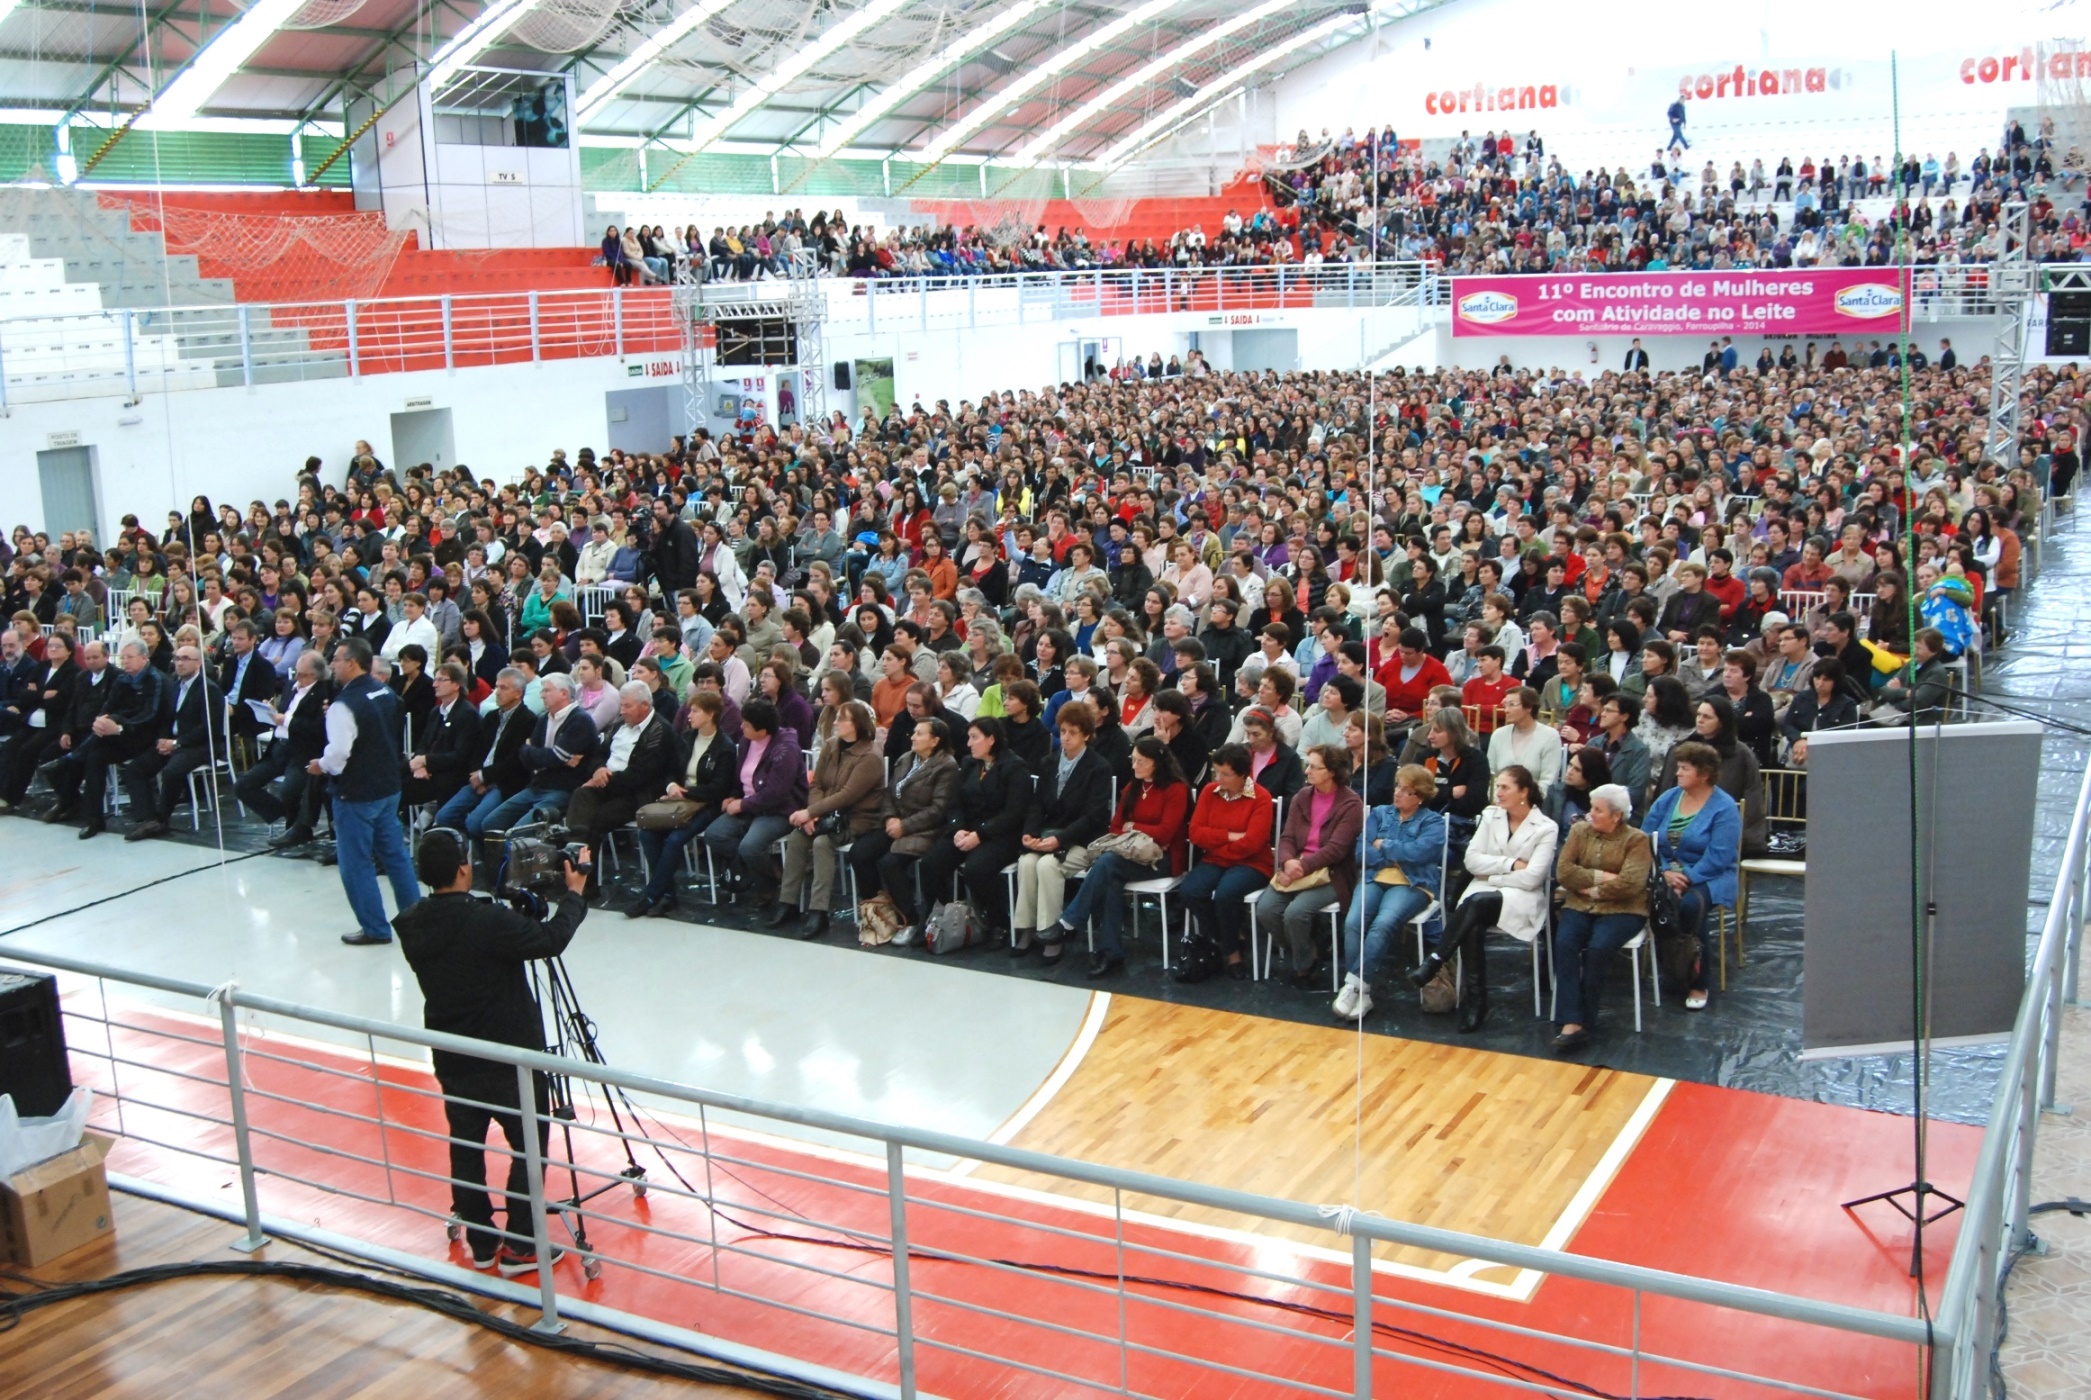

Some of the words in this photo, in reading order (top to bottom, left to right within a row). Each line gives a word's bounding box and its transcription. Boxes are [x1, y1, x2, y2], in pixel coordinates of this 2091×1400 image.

[1679, 64, 1826, 101] cortiana
[1425, 82, 1557, 116] cortiana
[1580, 282, 1673, 299] Encontro
[1679, 280, 1706, 298] de
[1713, 279, 1814, 297] Mulheres
[1462, 303, 1489, 312] Santa
[1490, 301, 1515, 312] Clara
[1839, 295, 1870, 307] Santa
[1871, 295, 1900, 306] Clara
[1553, 308, 1595, 322] com
[1601, 304, 1701, 322] Atividade
[1707, 307, 1735, 320] no
[1741, 302, 1796, 320] Leite
[1620, 323, 1632, 331] de
[1743, 321, 1766, 331] 2014
[651, 360, 674, 377] SAÍDA
